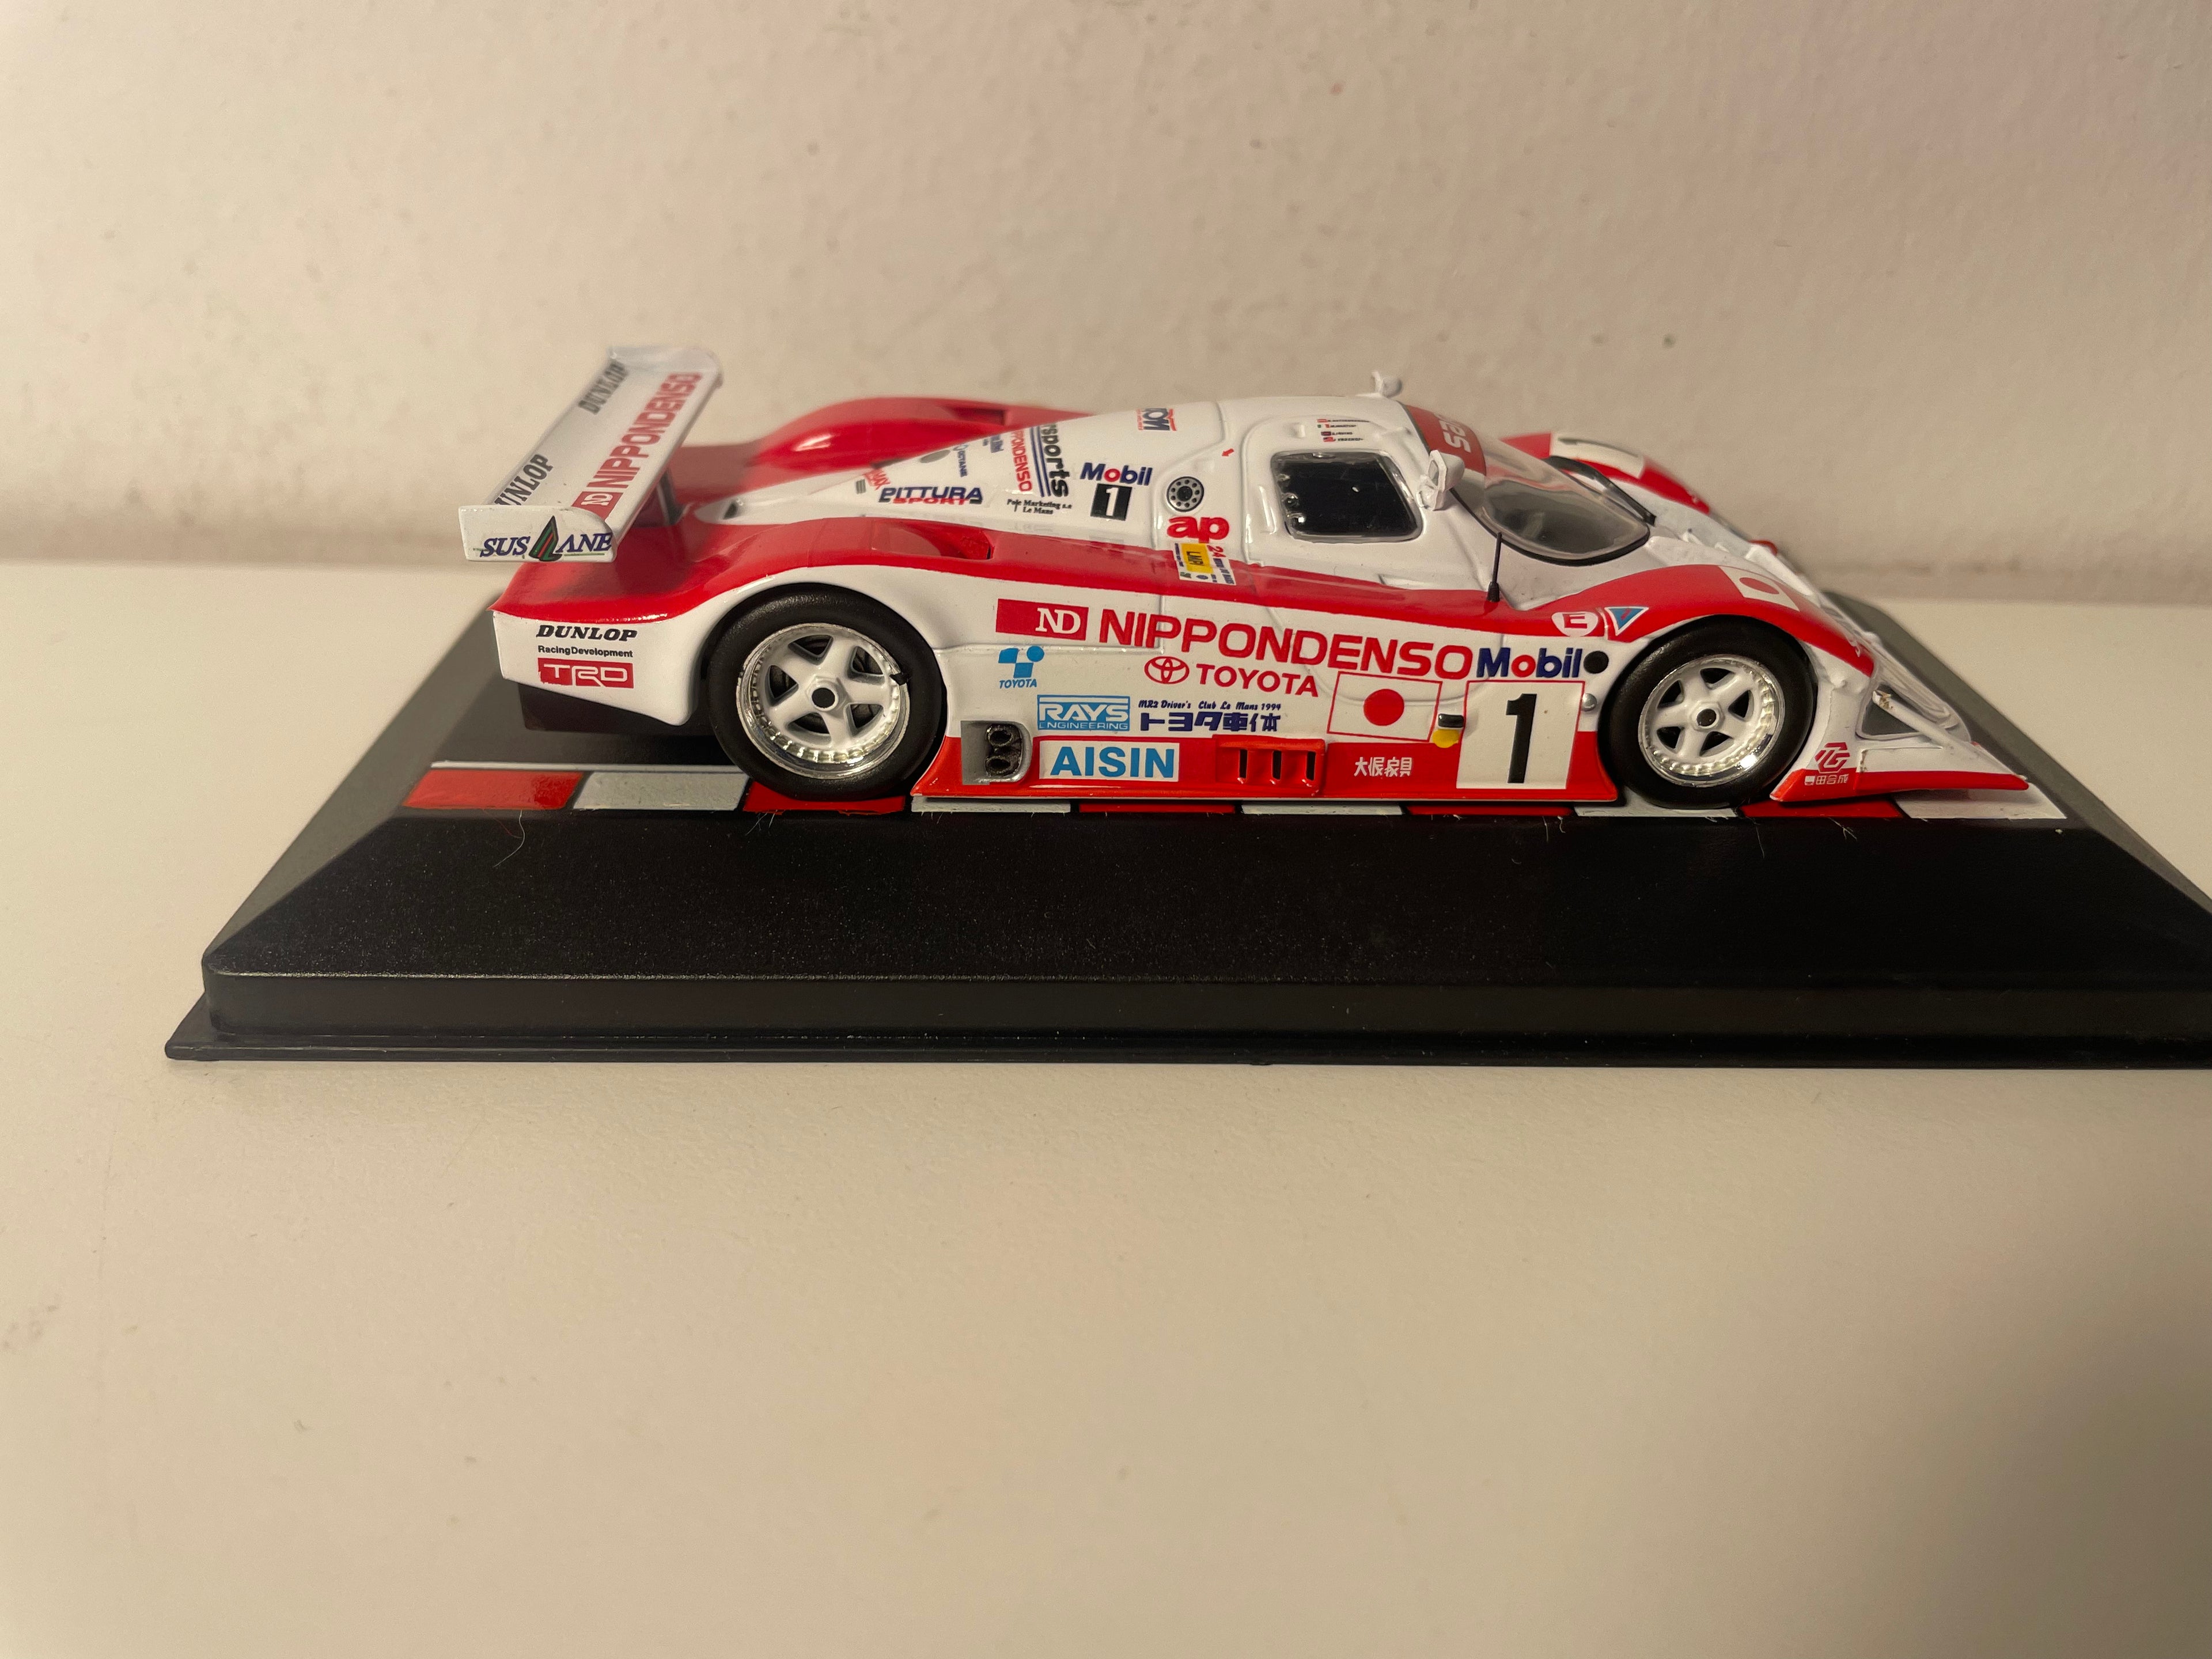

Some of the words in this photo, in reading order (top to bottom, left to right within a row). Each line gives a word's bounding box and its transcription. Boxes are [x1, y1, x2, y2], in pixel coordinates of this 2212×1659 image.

[586, 372, 703, 489] NIPPONDENSO
[494, 454, 553, 506] UNLOP
[1080, 463, 1153, 486] Mobil
[878, 486, 983, 505] PITTURA
[1023, 499, 1060, 510] Marketing
[1106, 487, 1119, 517] 1
[1166, 516, 1230, 543] ap
[1562, 613, 1588, 629] E
[536, 624, 638, 642] DUNLOP
[1035, 608, 1082, 634] ND
[1099, 609, 1472, 679] NIPPONDENSO
[1476, 647, 1582, 679] Mobil
[544, 664, 627, 687] TRD
[999, 679, 1037, 689] TOYOTA
[1196, 663, 1319, 698] TOYOTA
[1039, 703, 1128, 722] RAYS
[1138, 700, 1158, 709] MR2
[1161, 700, 1191, 709] Driver's
[1198, 700, 1216, 709] Club
[1220, 701, 1230, 710] Le
[1236, 702, 1258, 710] Mans
[1141, 711, 1281, 732] トヨタ車体
[1506, 693, 1537, 783] 1
[1050, 746, 1175, 778] AISIN
